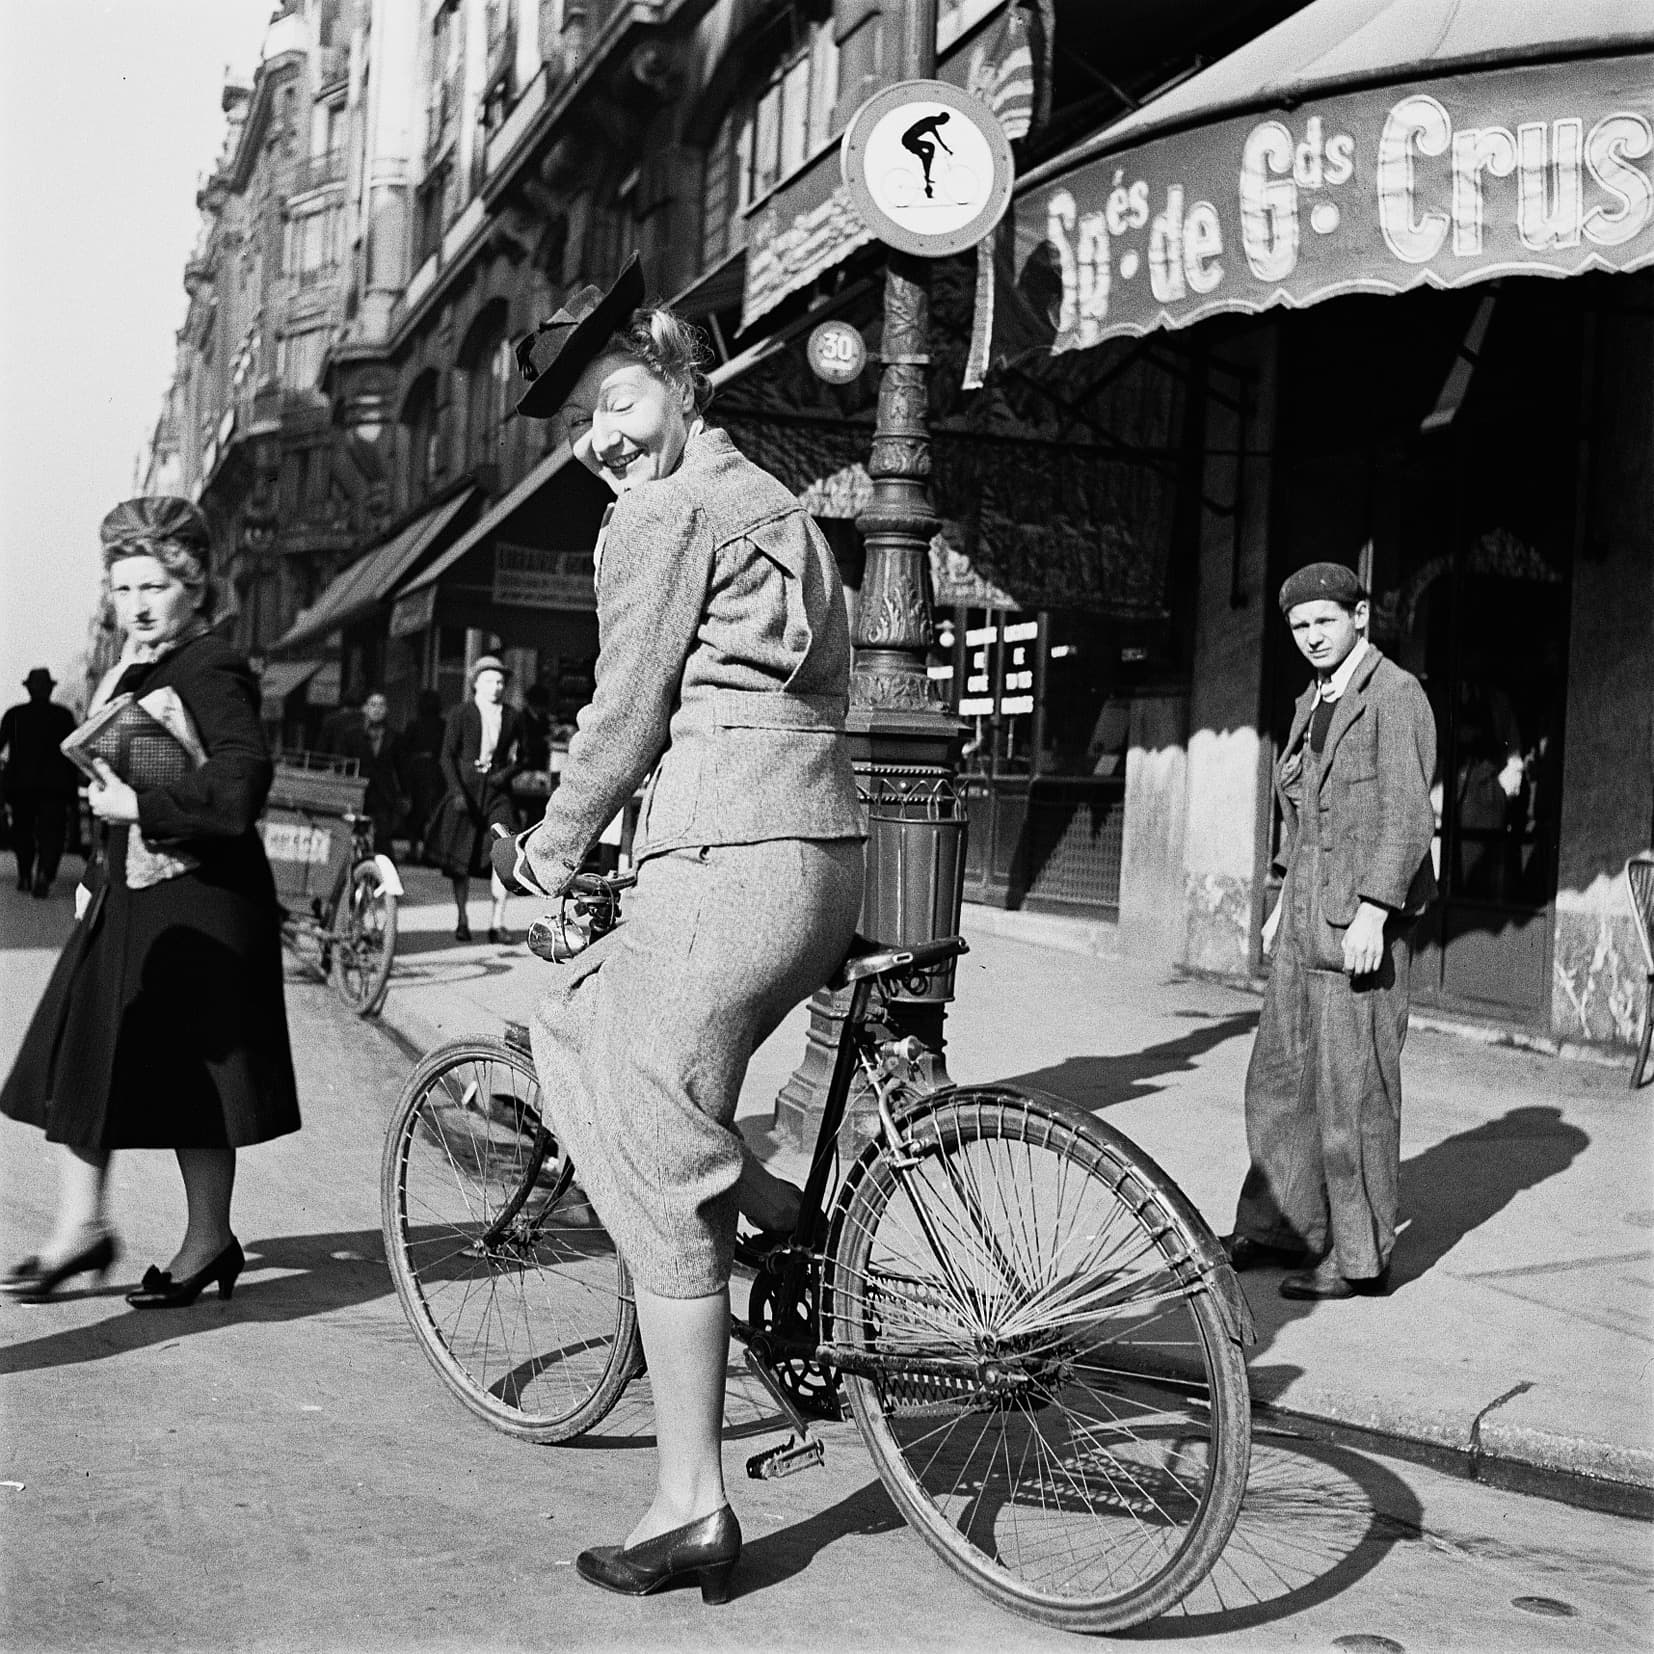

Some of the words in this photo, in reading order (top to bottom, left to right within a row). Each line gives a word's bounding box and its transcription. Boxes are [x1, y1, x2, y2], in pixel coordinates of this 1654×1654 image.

[1148, 183, 1225, 303] de
[1377, 94, 1654, 264] Crus
[822, 332, 853, 361] 30
